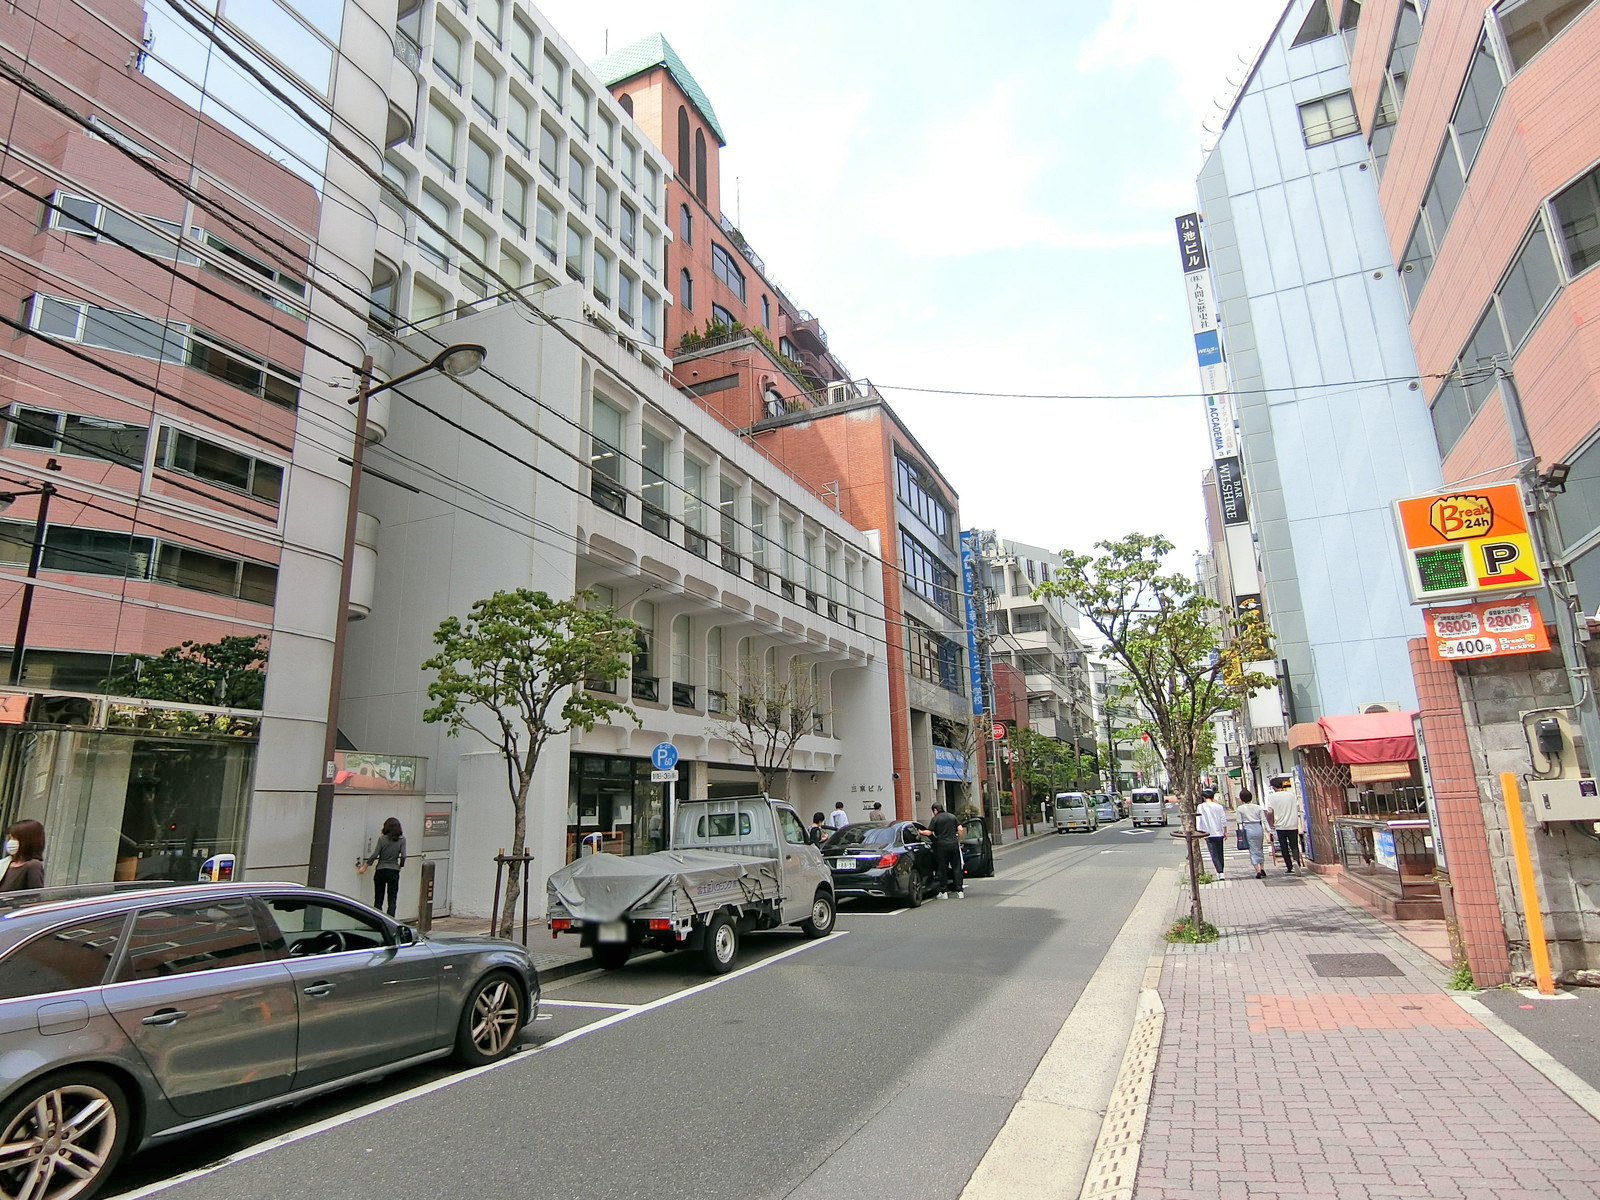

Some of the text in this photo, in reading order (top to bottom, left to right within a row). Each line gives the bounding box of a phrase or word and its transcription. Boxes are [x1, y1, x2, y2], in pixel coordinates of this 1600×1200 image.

[1180, 218, 1200, 267] 小池ビル
[1210, 407, 1223, 450] ACCADEMIA
[1219, 463, 1237, 519] WILSHIRE
[1233, 480, 1243, 499] BAR
[1439, 504, 1490, 535] Break
[1464, 517, 1490, 529] 24h
[1481, 542, 1520, 575] P
[657, 749, 668, 766] P
